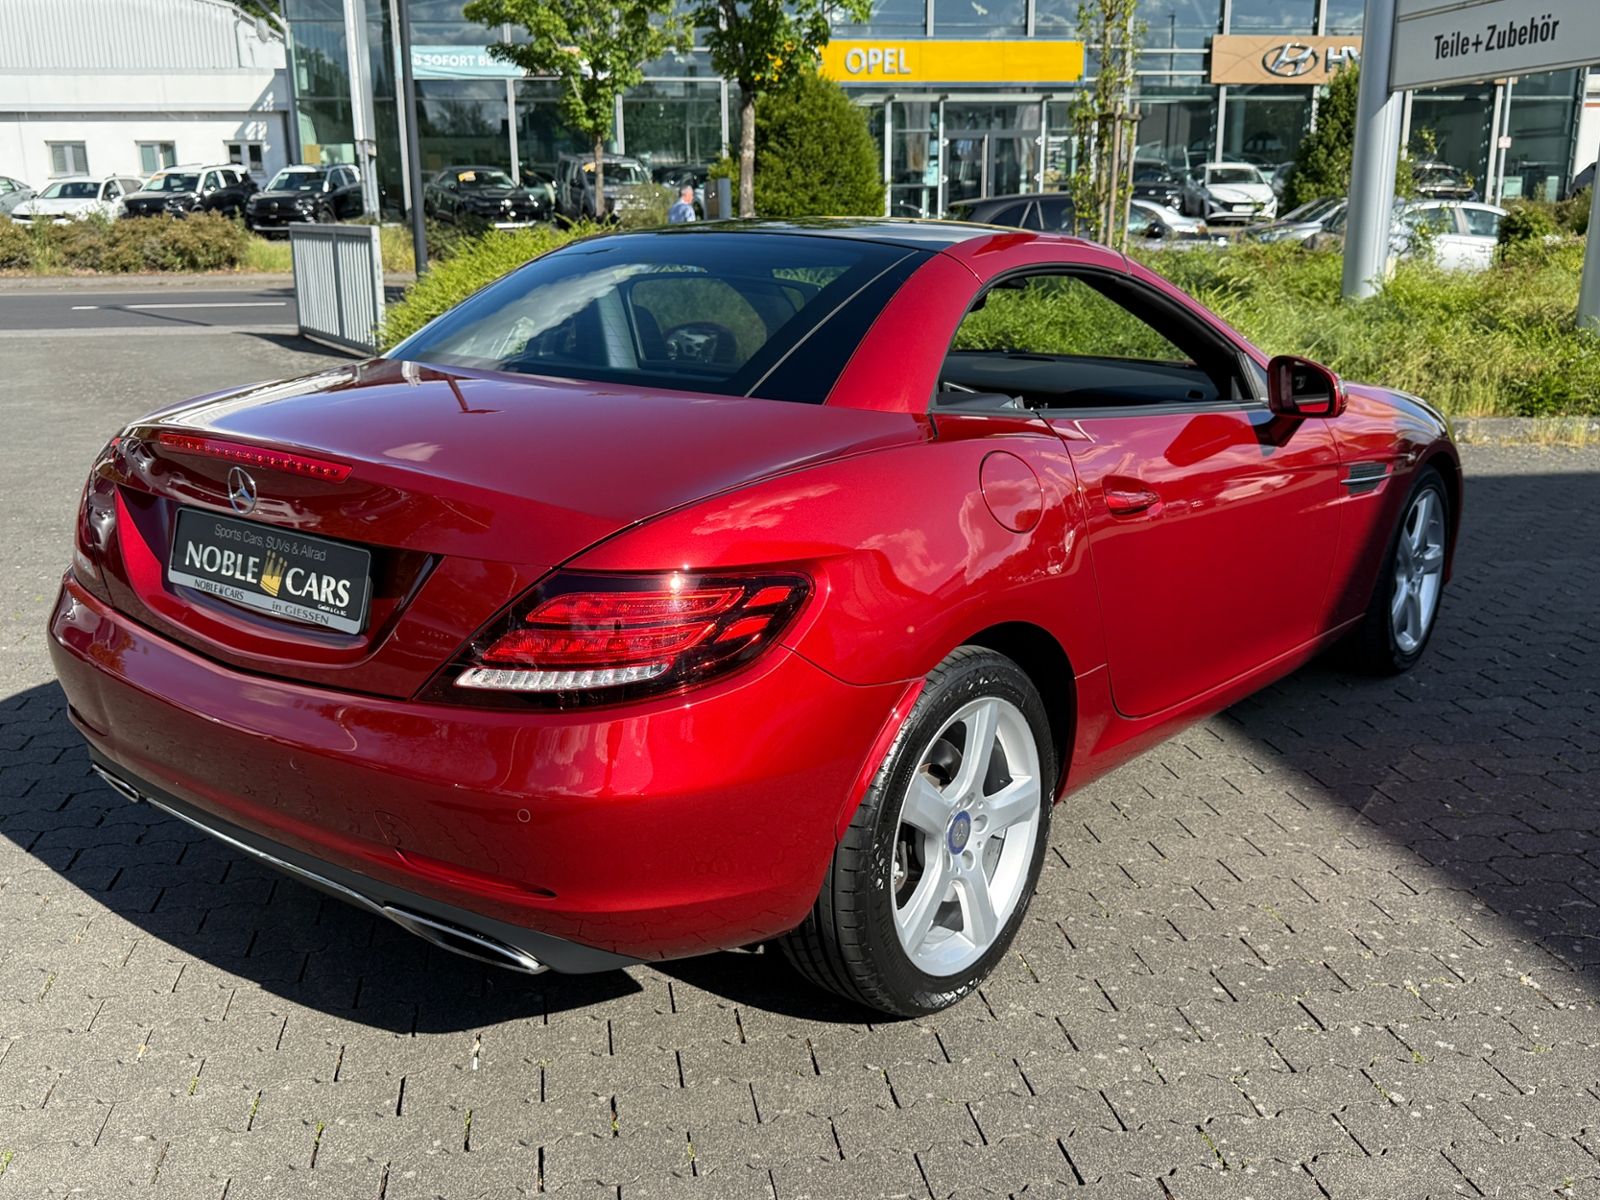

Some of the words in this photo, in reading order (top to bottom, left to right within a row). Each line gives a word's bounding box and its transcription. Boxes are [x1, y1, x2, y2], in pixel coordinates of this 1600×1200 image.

[1434, 13, 1560, 60] Teile+Zubehör
[423, 55, 475, 67] SOFORT
[845, 48, 912, 75] OPEL
[214, 523, 242, 541] Sports
[265, 536, 290, 553] SUVs
[291, 542, 298, 555] &
[300, 545, 327, 562] Allrad
[185, 540, 260, 584] NOBLE
[285, 567, 351, 608] CARS
[194, 579, 219, 593] NOBLE
[224, 588, 245, 601] CARS
[272, 600, 282, 611] in
[284, 605, 329, 625] GIESSEN
